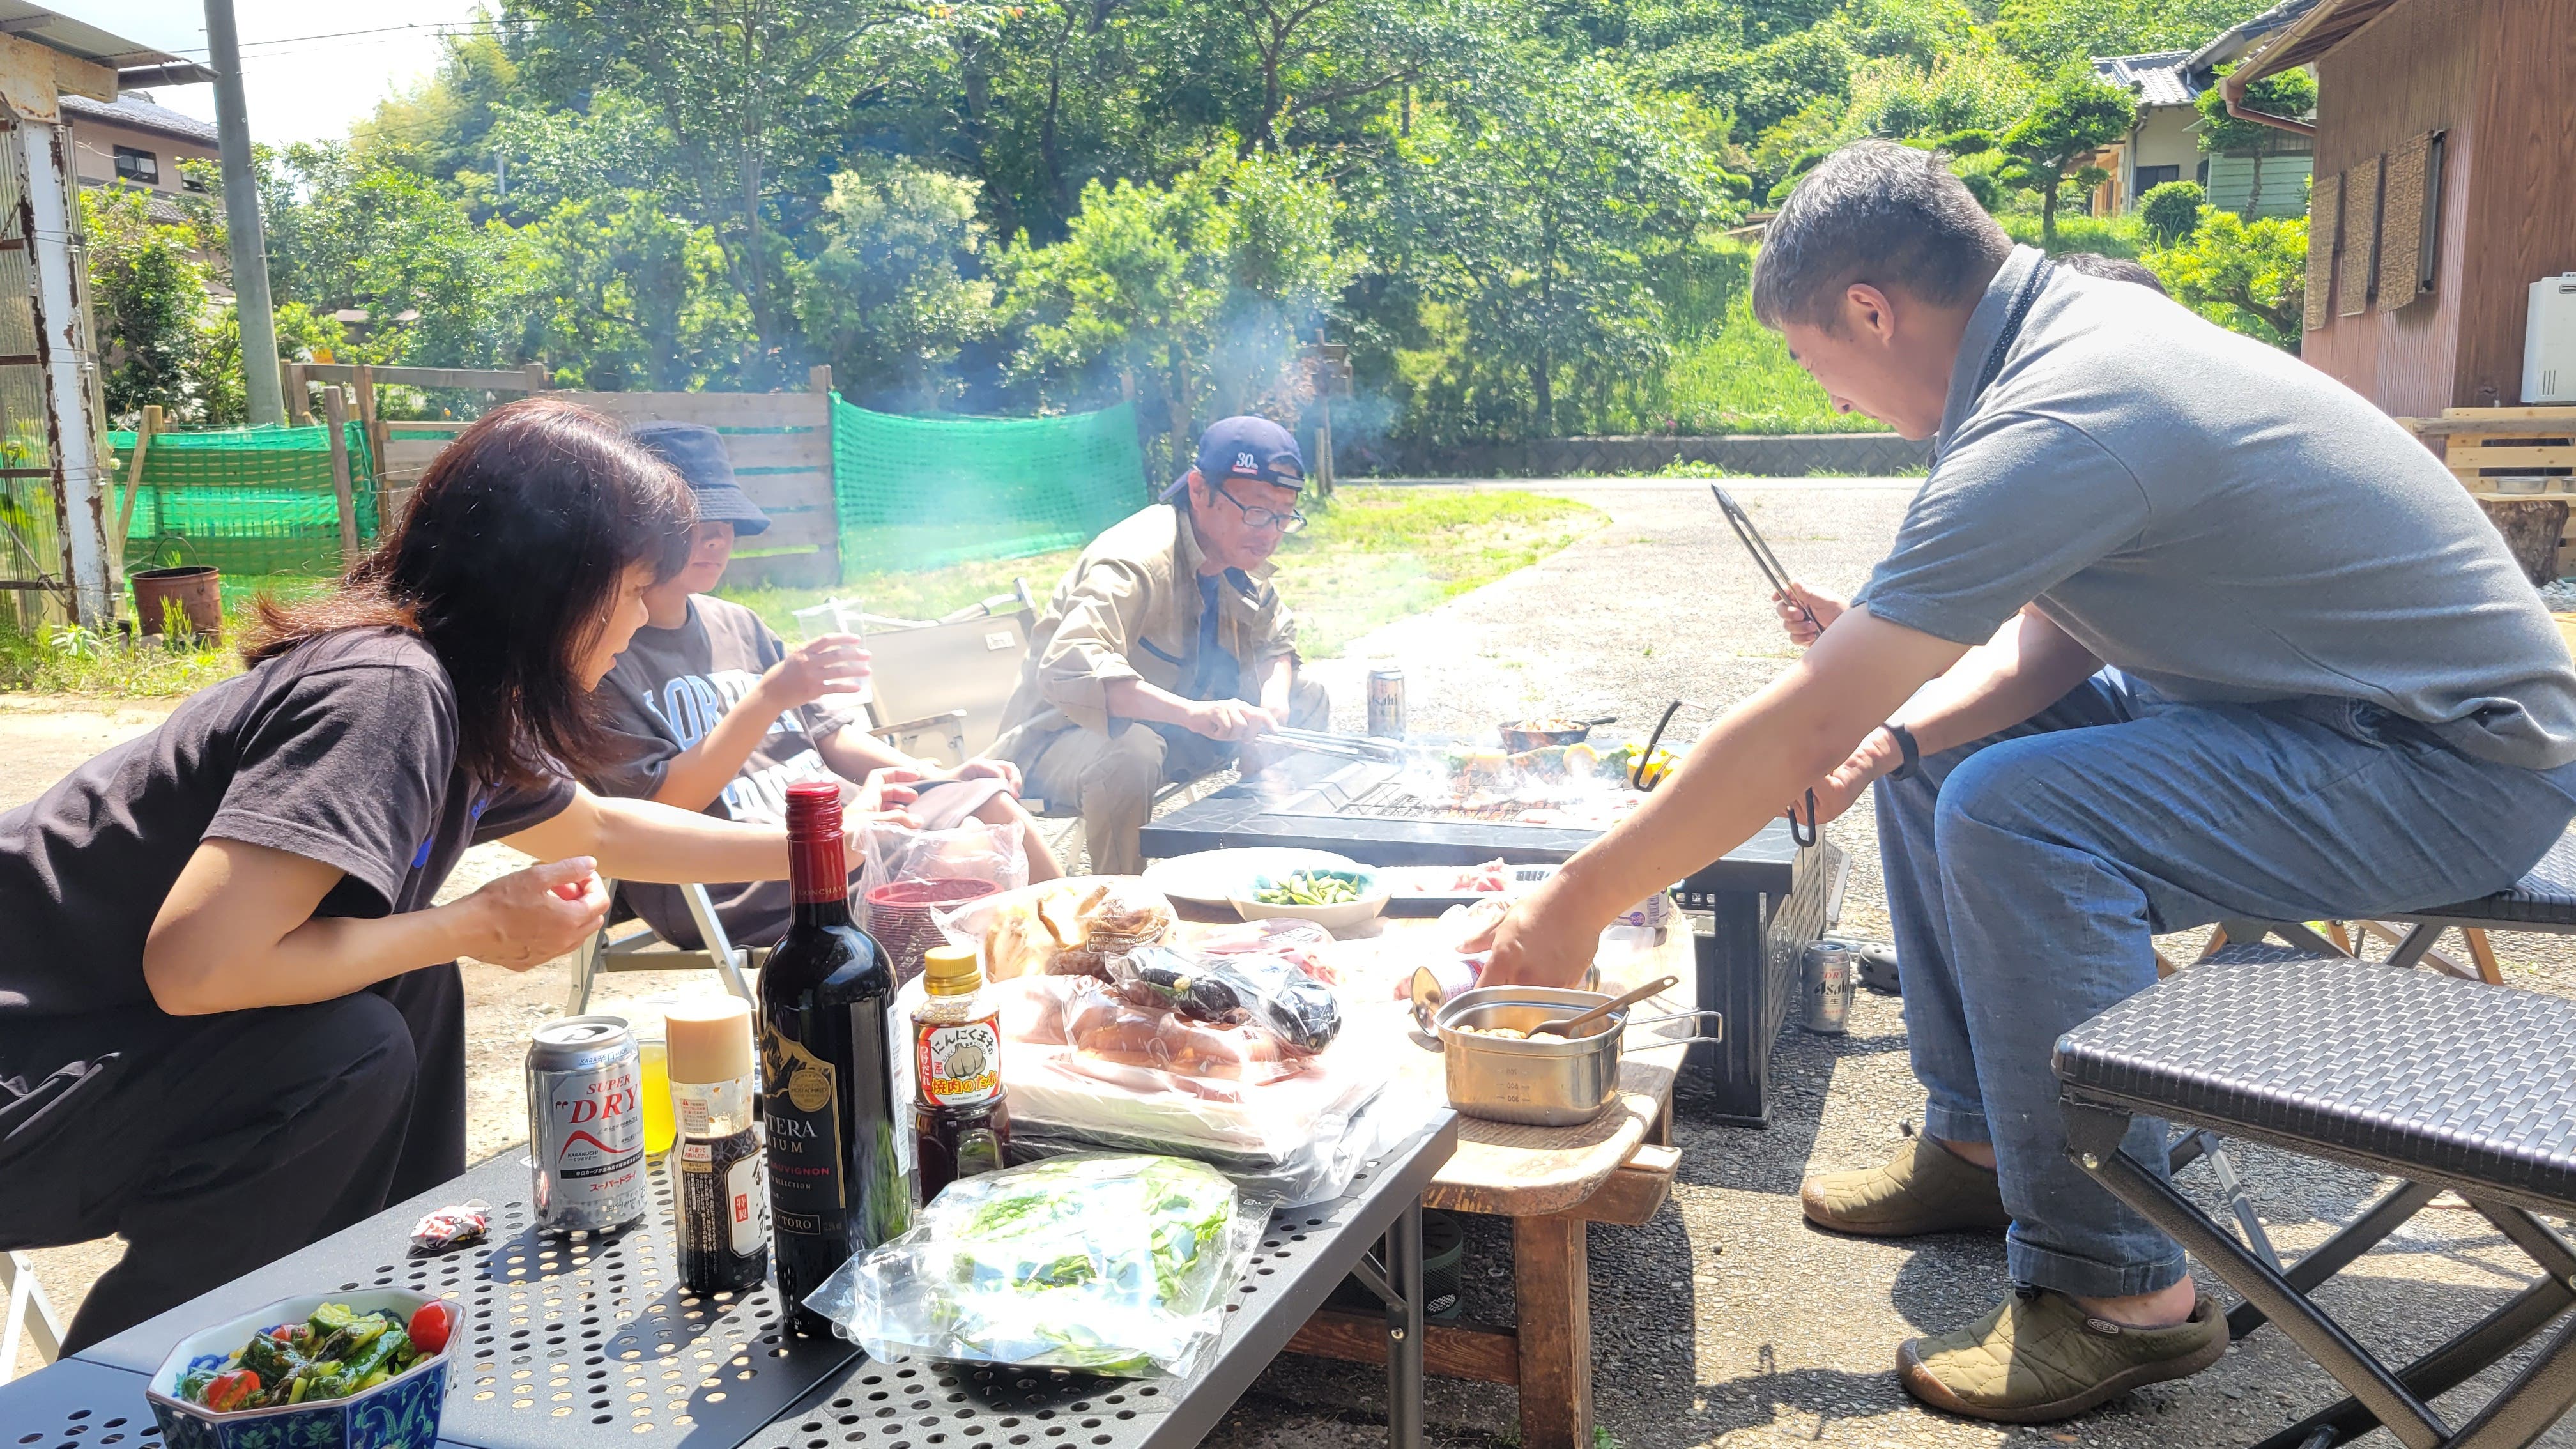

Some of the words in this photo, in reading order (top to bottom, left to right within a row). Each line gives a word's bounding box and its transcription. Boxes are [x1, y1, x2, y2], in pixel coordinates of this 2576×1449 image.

[798, 886, 838, 896] CONCHA
[932, 1029, 994, 1055] にんにく王子の
[579, 1057, 597, 1065] KARA
[920, 1045, 931, 1086] つけだれ
[586, 1073, 631, 1094] SUPER
[932, 1070, 997, 1095] 焼肉のたれ
[767, 1113, 818, 1138] TERA
[567, 1150, 599, 1158] KARAKUCHI
[590, 1170, 636, 1192] スーパードライ
[736, 1197, 747, 1220] 特製
[782, 1216, 812, 1230] TORO
[2089, 1321, 2117, 1332] KEEN
